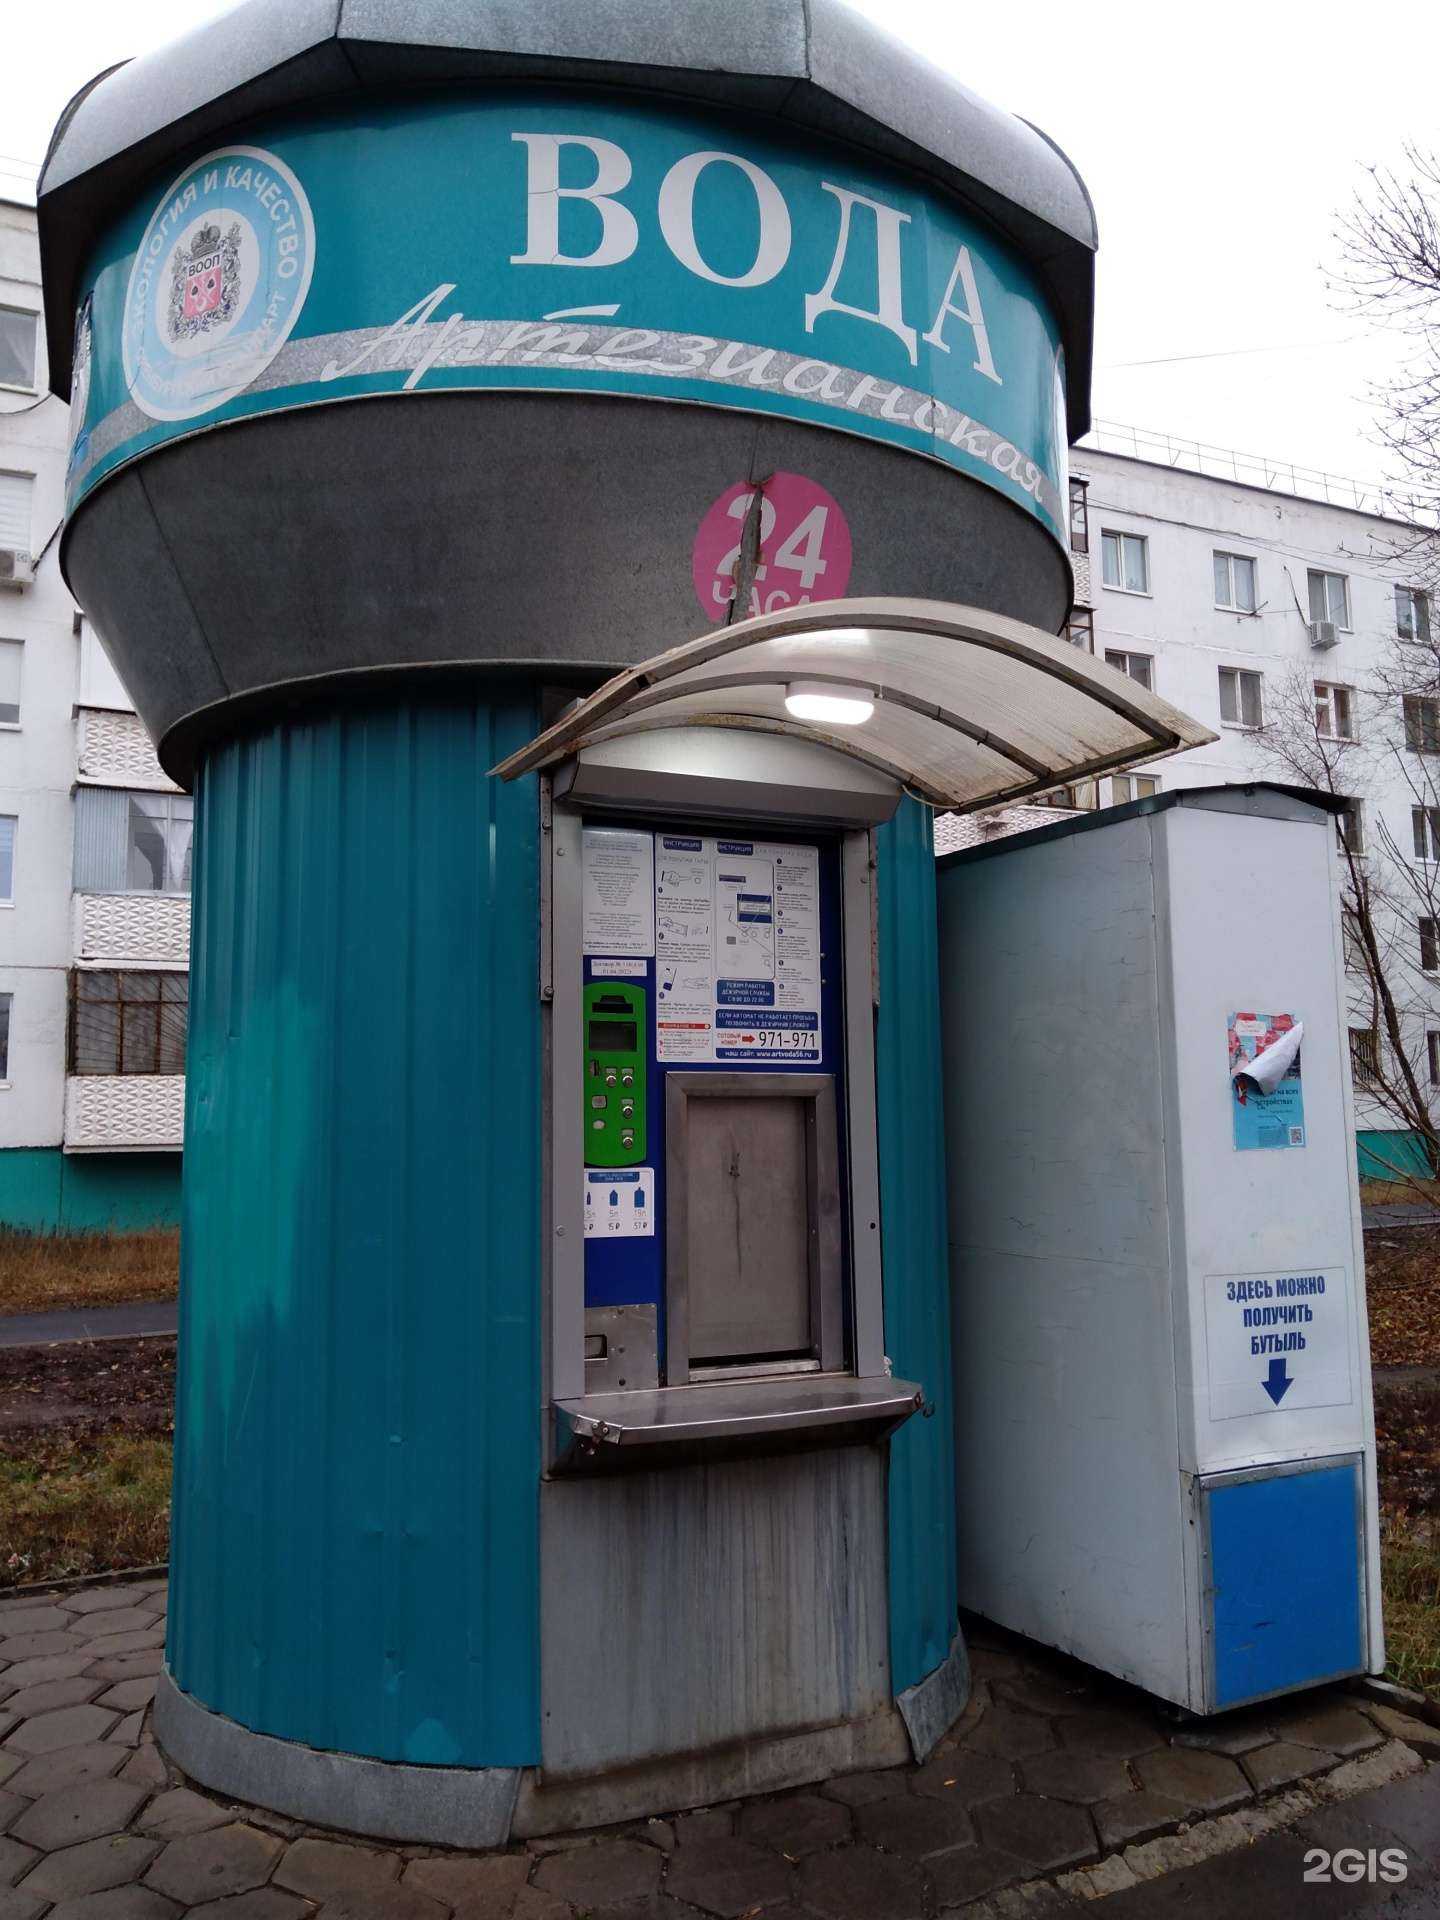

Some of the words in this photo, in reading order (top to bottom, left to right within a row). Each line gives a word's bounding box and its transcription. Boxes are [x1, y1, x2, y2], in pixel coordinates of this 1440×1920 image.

[204, 173, 218, 194] И
[224, 165, 299, 279] КАЧЕСТВО
[188, 254, 221, 277] ВООП
[510, 132, 1003, 386] ВОДА
[319, 283, 1044, 504] Артезианская
[716, 493, 828, 589] 24
[759, 1031, 816, 1048] 971-971
[1226, 1279, 1273, 1303] ЗДЕСЬ
[1276, 1275, 1326, 1298] МОЖНО
[1243, 1303, 1313, 1328] ПОЛУЧИТЬ
[1250, 1331, 1306, 1355] БУТЫЛЬ
